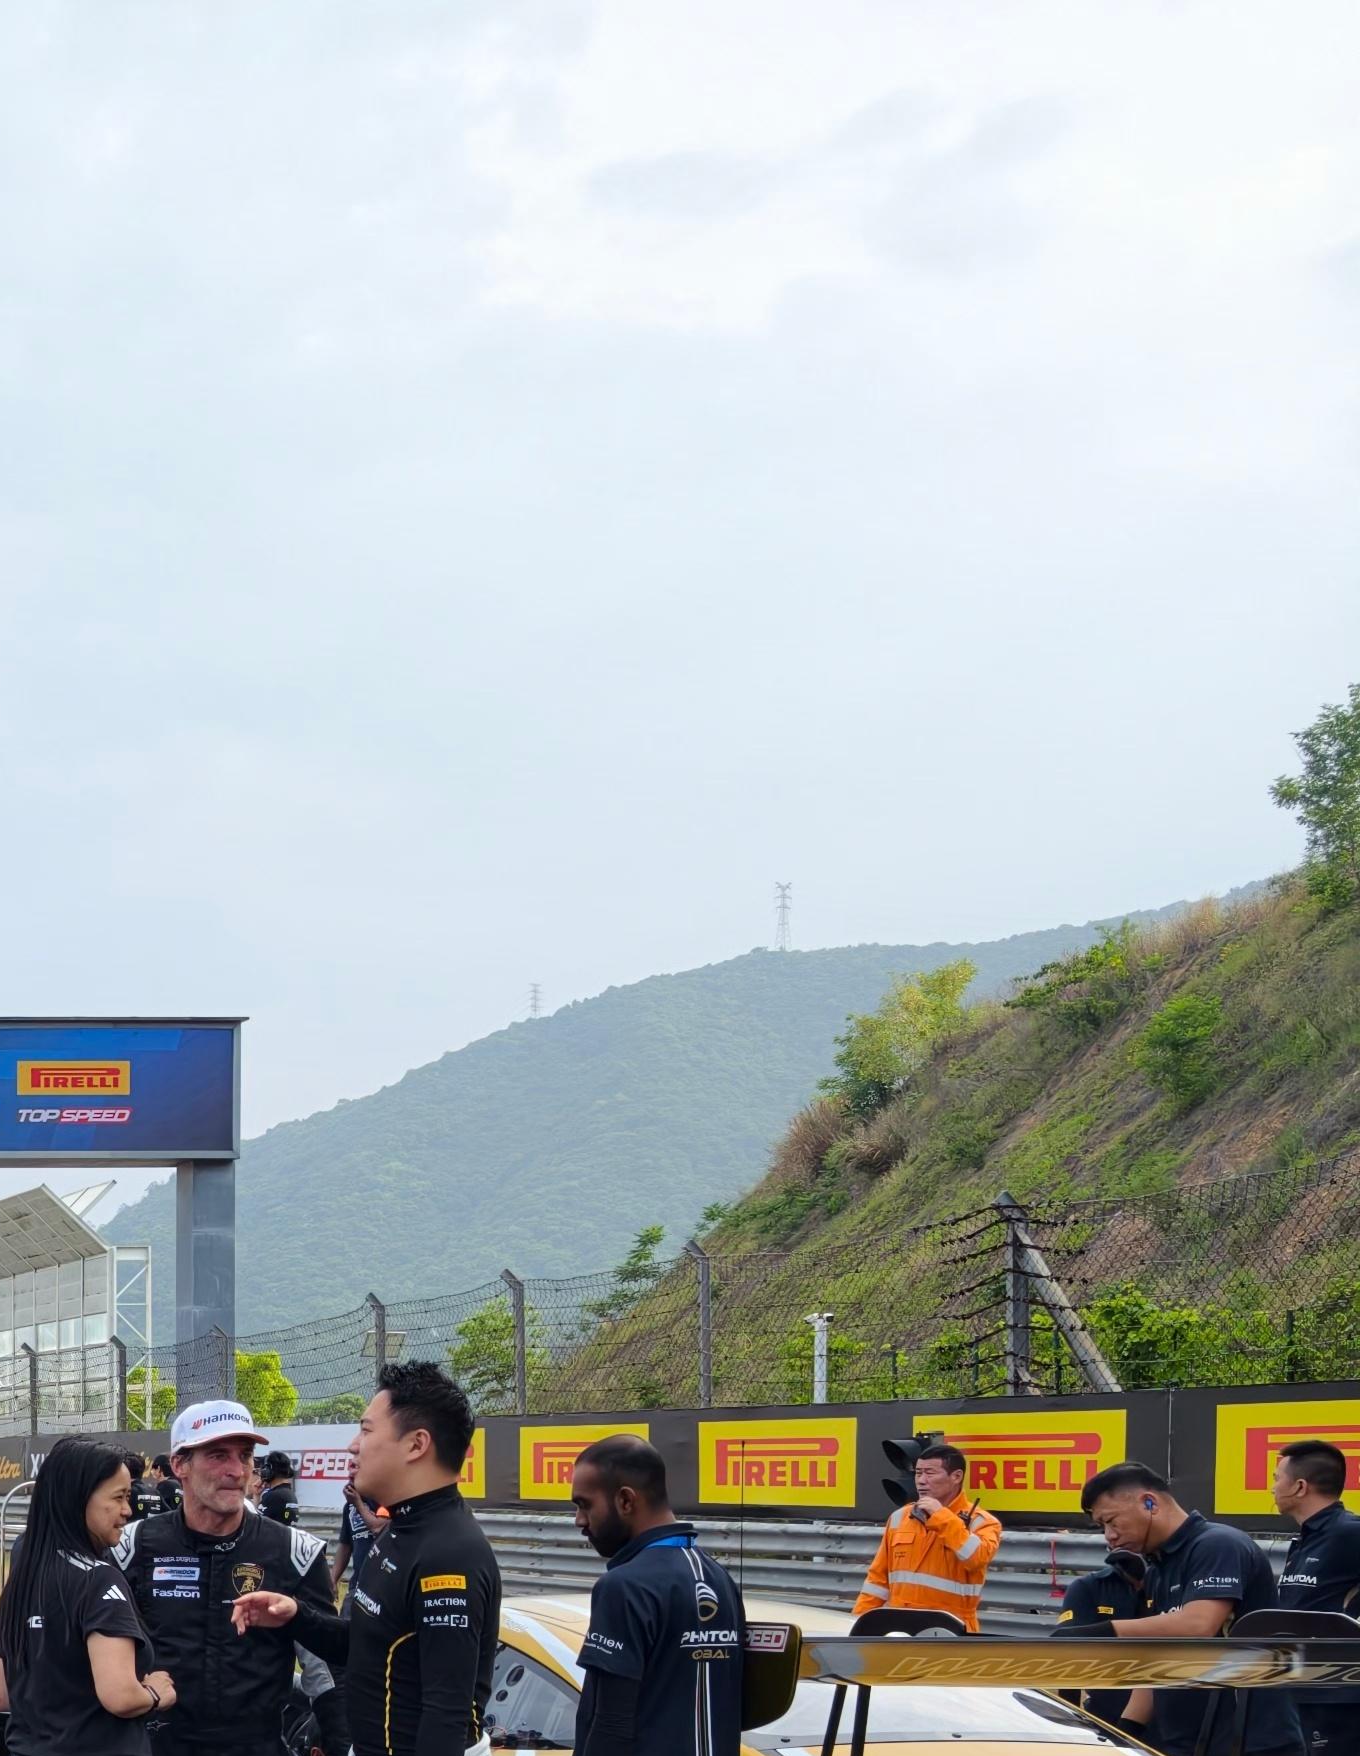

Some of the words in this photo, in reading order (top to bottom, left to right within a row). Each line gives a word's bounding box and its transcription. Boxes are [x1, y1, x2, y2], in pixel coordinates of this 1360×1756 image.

[31, 1068, 120, 1088] PIRELLI
[18, 1109, 59, 1123] TOP
[60, 1108, 131, 1123] SPEED
[715, 1437, 839, 1487] PIRELLI
[153, 1589, 200, 1598] Fastron
[424, 1598, 467, 1607] TRACTION
